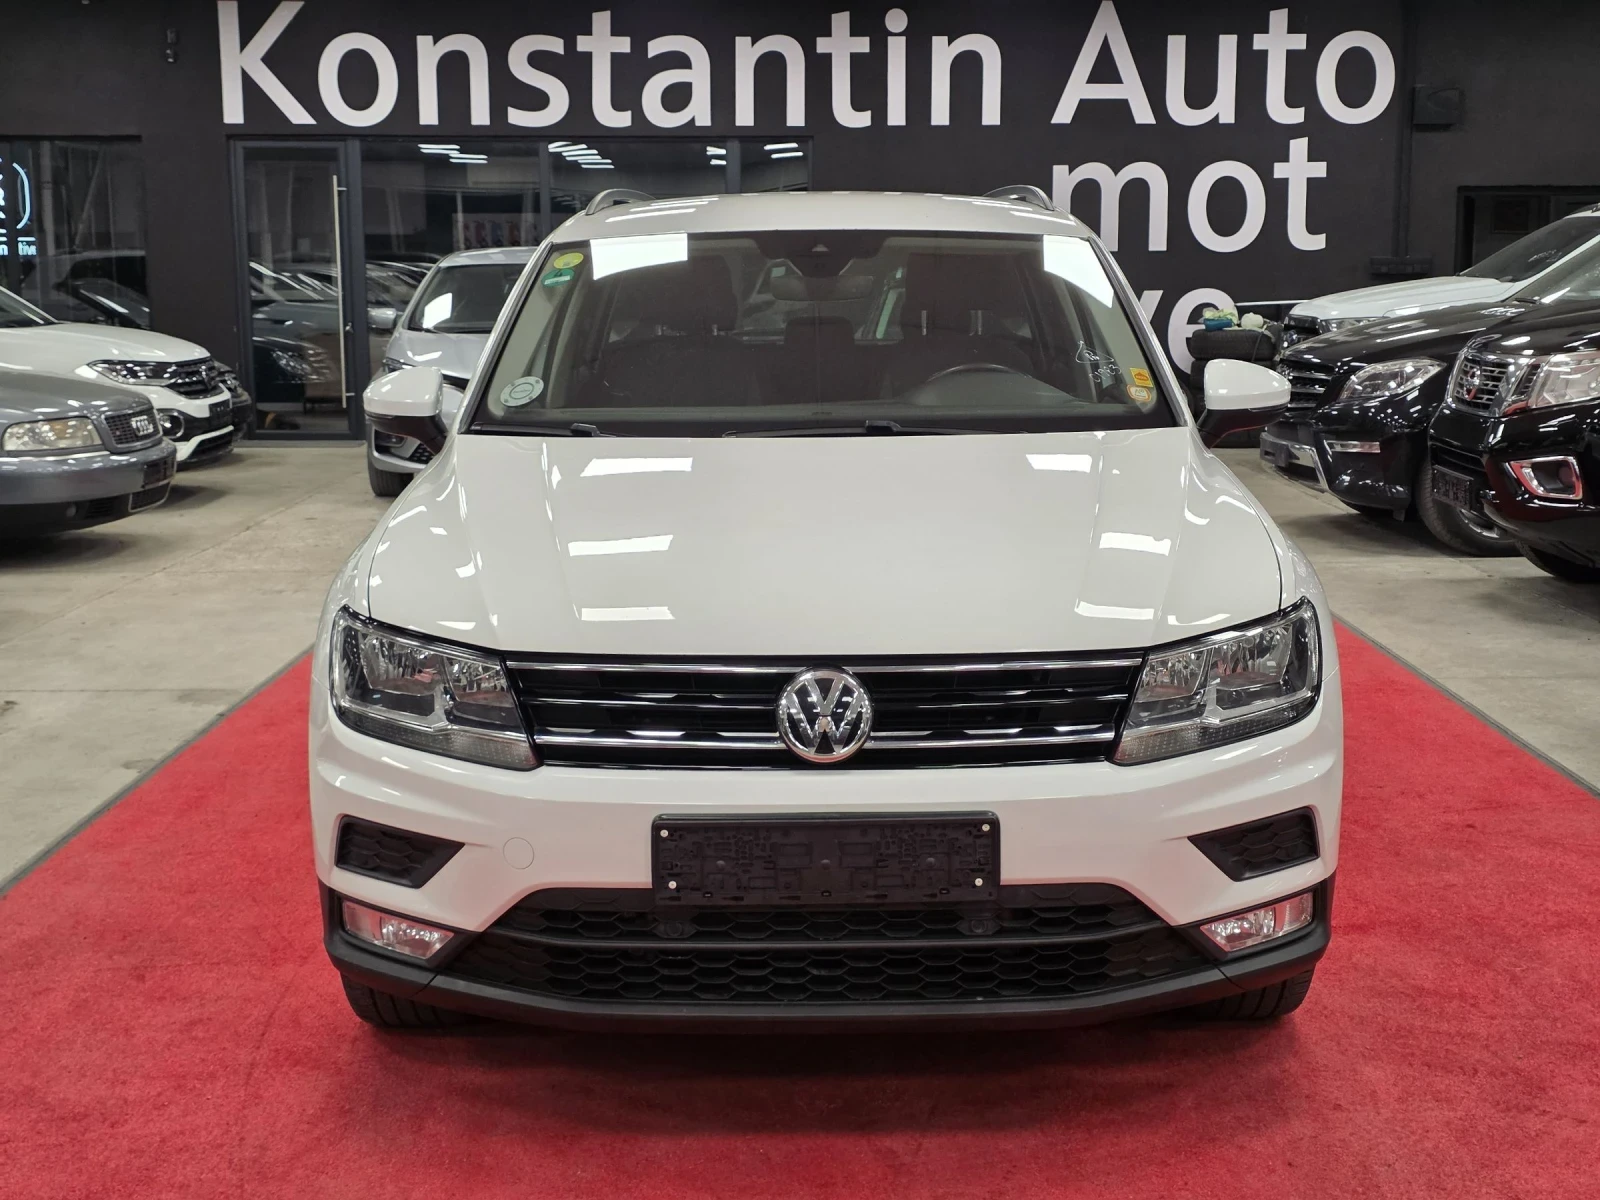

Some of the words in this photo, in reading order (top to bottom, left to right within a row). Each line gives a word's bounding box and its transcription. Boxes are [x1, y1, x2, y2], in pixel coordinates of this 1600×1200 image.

[217, 1, 1002, 128] Konstantin
[1050, 0, 1396, 127] Auto
[1050, 136, 1327, 254] mot
